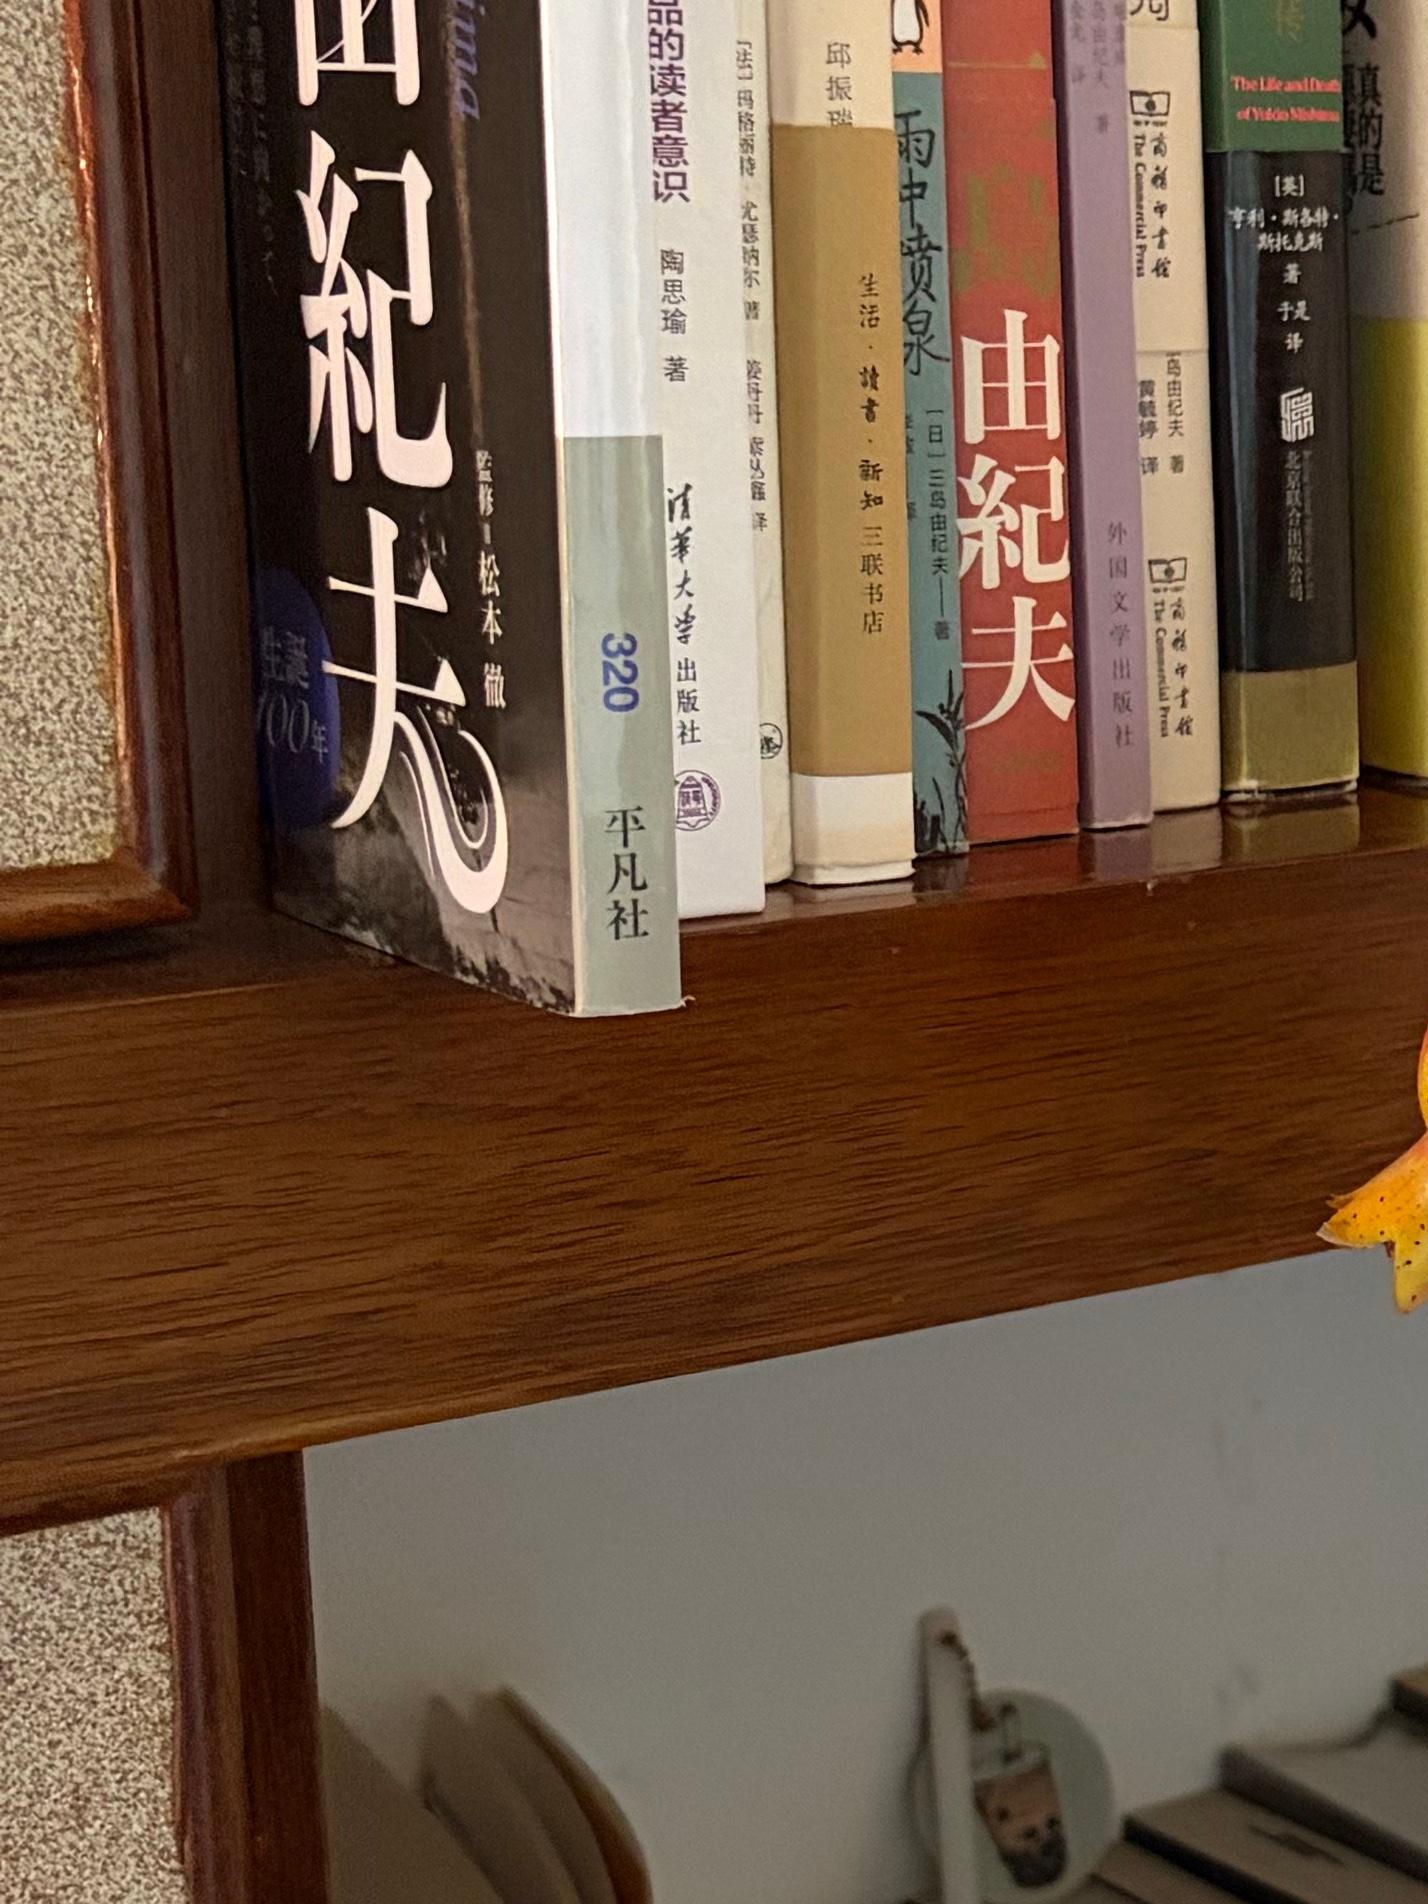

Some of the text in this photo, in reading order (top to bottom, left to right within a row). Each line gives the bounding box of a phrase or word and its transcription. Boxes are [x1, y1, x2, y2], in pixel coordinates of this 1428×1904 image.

[660, 248, 689, 383] 陶思瑜 著
[1277, 299, 1311, 323] 于是
[1166, 352, 1184, 437] 岛由纪夫
[600, 632, 640, 714] 320
[1107, 522, 1135, 748] 外国文学出版社
[604, 807, 650, 941] 平凡社
